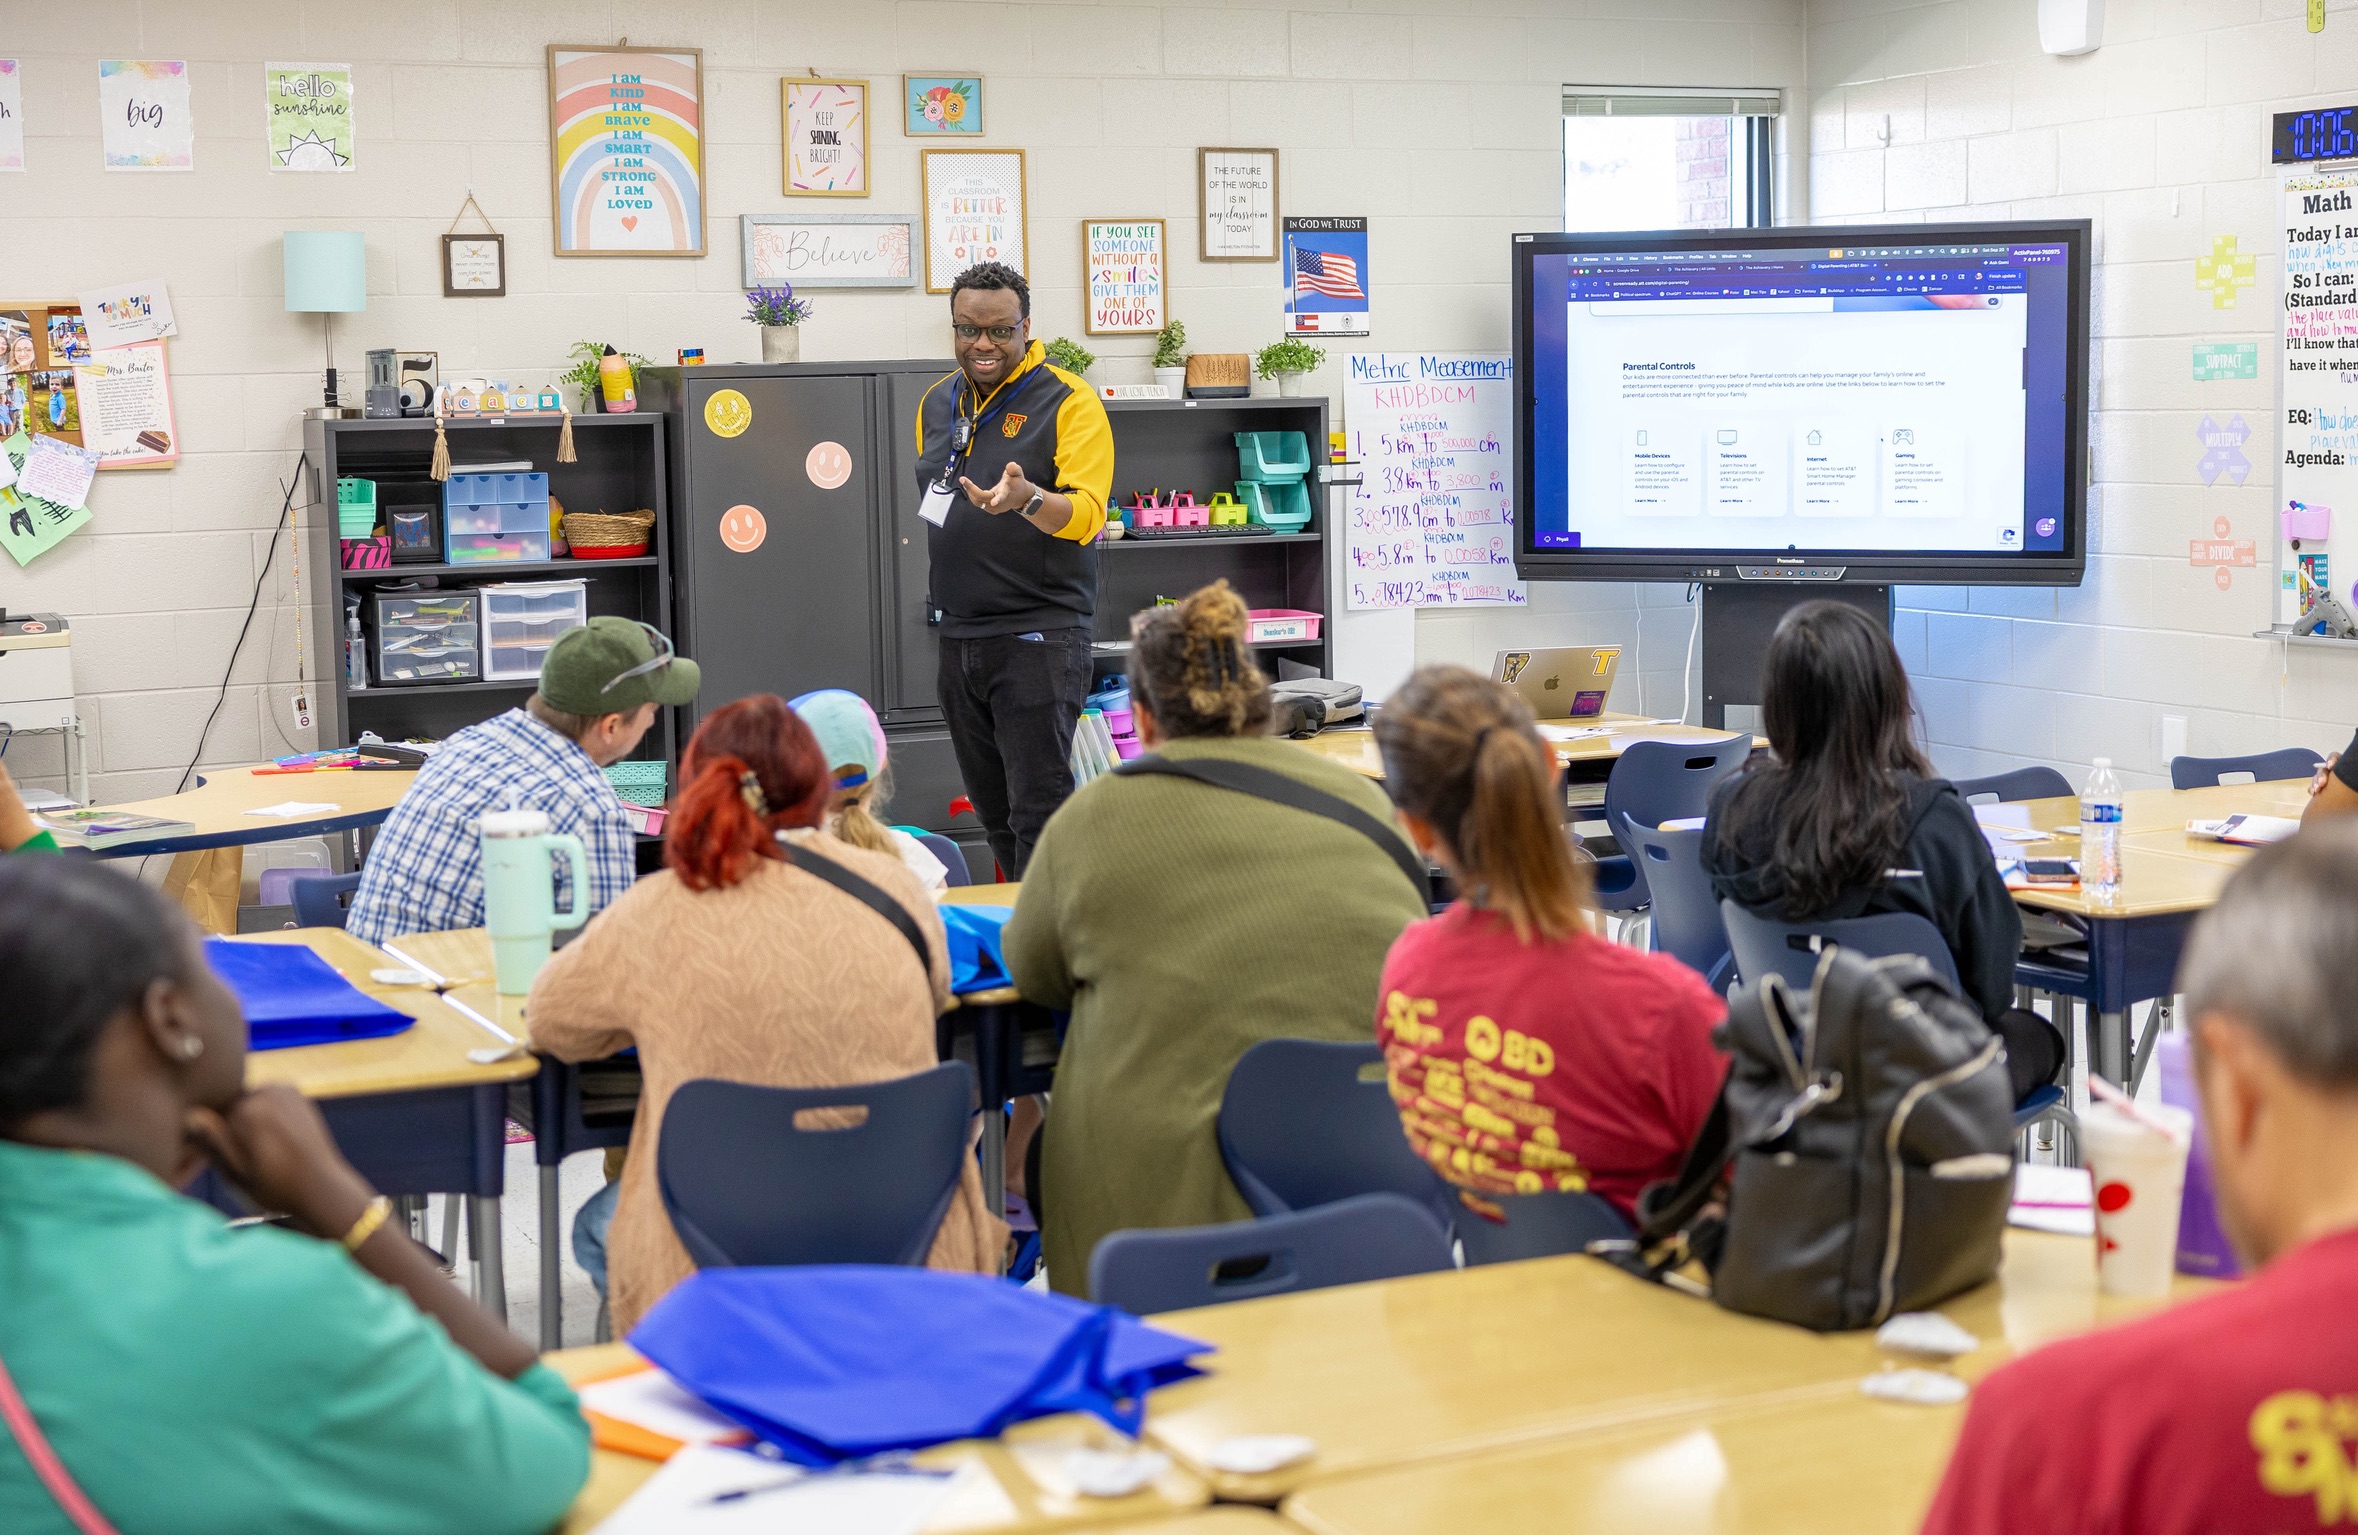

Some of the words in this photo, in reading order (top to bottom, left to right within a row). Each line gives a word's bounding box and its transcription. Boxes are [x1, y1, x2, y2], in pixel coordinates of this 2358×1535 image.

[280, 75, 336, 98] hello
[612, 74, 617, 84] I
[127, 97, 163, 128] big
[274, 99, 346, 116] sunshine
[613, 102, 617, 111] I
[816, 111, 834, 126] KEEP
[614, 130, 618, 140] I
[810, 130, 841, 145] SHINING
[614, 158, 619, 167] I
[810, 150, 840, 163] BRIGHT!
[1231, 167, 1261, 175] FUTURE
[616, 186, 620, 195] I
[954, 196, 1007, 214] BETTER
[2303, 190, 2352, 214] Math
[1210, 212, 1222, 224] my
[1226, 206, 1268, 220] classroom
[1299, 219, 1319, 228] GOD
[1334, 218, 1361, 228] TRUST
[948, 225, 980, 243] ARE
[986, 225, 1002, 242] IN
[1092, 226, 1102, 238] IF
[1107, 226, 1131, 238] YOU
[1137, 226, 1155, 238] SEE
[2287, 226, 2332, 244] Today
[2336, 225, 2340, 239] I
[786, 230, 878, 270] Believe
[1094, 240, 1154, 252] SOMEONE
[2288, 245, 2310, 259] how
[2315, 241, 2346, 261] digits
[969, 246, 982, 264] IT
[1092, 254, 1146, 266] WITHOUT
[1102, 266, 1148, 283] smile
[2216, 264, 2232, 278] ADD
[2287, 262, 2315, 273] when
[2294, 274, 2311, 288] So
[2316, 273, 2320, 286] I
[2324, 273, 2354, 286] can:
[1093, 284, 1118, 296] GIVE
[1124, 284, 1158, 296] THEM
[98, 298, 130, 314] THANK
[130, 295, 150, 307] YOU
[1104, 297, 1127, 308] ONE
[1133, 297, 1148, 308] OF
[106, 314, 118, 322] SO
[120, 304, 151, 319] MUCH
[1098, 309, 1155, 326] YOURS
[2288, 311, 2308, 324] the
[2311, 308, 2335, 326] place
[2287, 324, 2306, 338] and
[2310, 324, 2329, 337] how
[2333, 322, 2342, 334] to
[2304, 338, 2334, 350] know
[1352, 354, 1410, 379] Metric
[1623, 362, 1658, 370] Parental
[1660, 362, 1696, 370] Controls
[2206, 354, 2242, 368] SUBTRACT
[2290, 359, 2316, 370] have
[2319, 359, 2326, 370] it
[106, 366, 125, 376] Mrs.
[128, 362, 154, 374] Baxter
[1375, 383, 1476, 409] KHDBDCM
[2288, 410, 2312, 425] EQ:
[2314, 407, 2336, 430] How
[1400, 422, 1448, 432] KHDBDCM
[1382, 434, 1392, 455] 5
[1421, 433, 1438, 452] to
[1442, 438, 1476, 449] 500,000
[1480, 440, 1500, 454] cm
[2206, 432, 2241, 447] MULTIPLY
[2310, 436, 2339, 452] place
[1412, 457, 1455, 470] KHDBDCM
[2285, 450, 2344, 468] Agenda:
[1446, 474, 1480, 488] 3,800
[1446, 508, 1455, 526] to
[1426, 544, 1436, 564] to
[2209, 546, 2234, 560] DIVIDE
